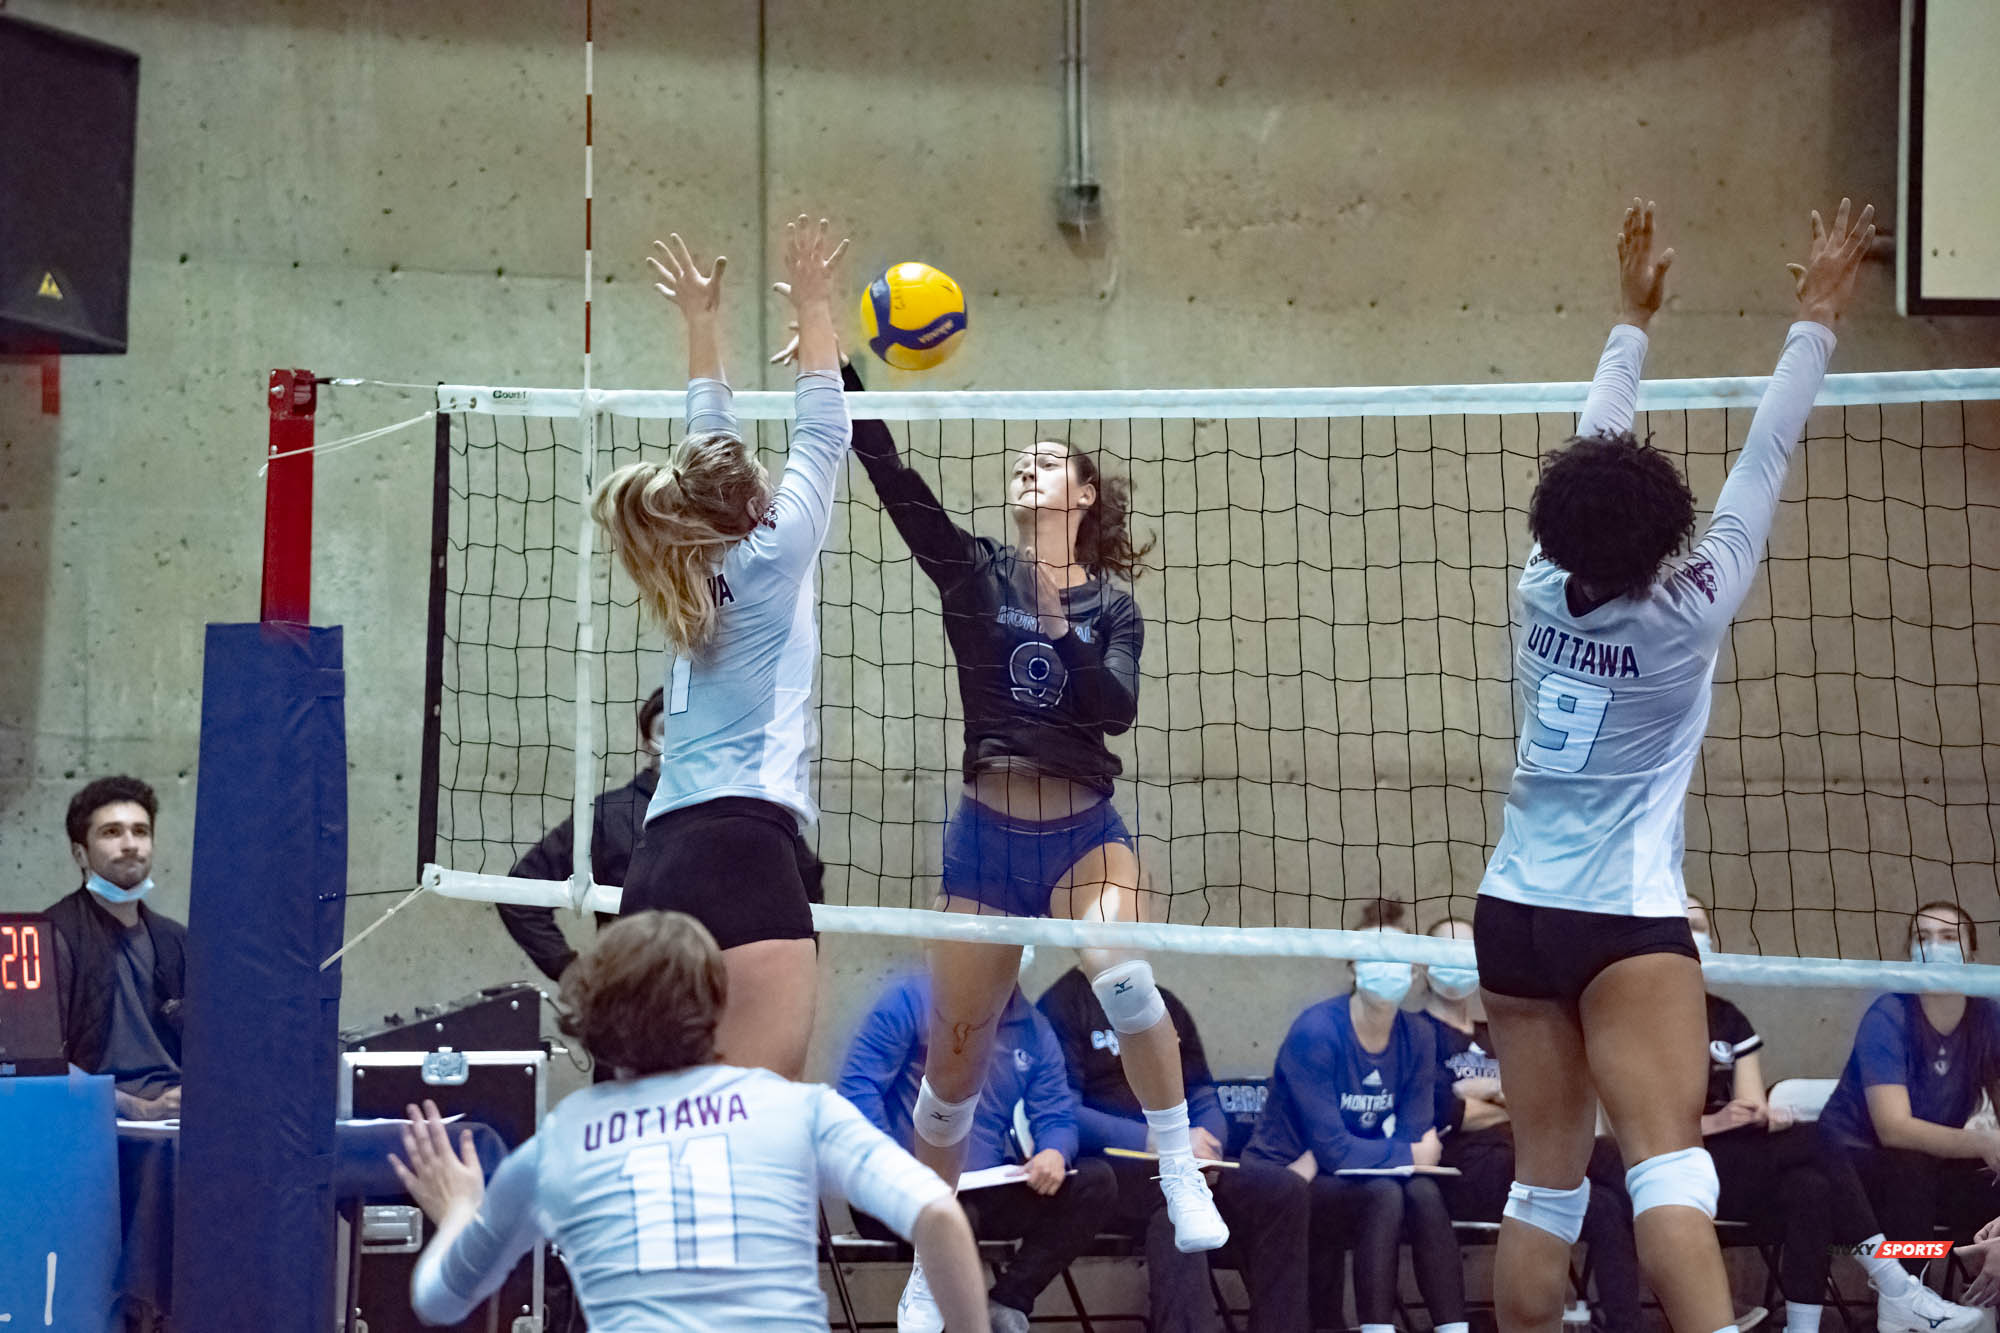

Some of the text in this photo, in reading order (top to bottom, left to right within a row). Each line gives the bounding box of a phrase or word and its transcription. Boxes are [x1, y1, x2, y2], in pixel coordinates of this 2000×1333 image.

[1009, 641, 1068, 708] 9
[1527, 622, 1640, 678] UOTTAWA
[1526, 671, 1615, 773] 9
[0, 926, 41, 990] 20
[584, 1094, 748, 1152] UOTTAWA
[618, 1132, 739, 1274] 11
